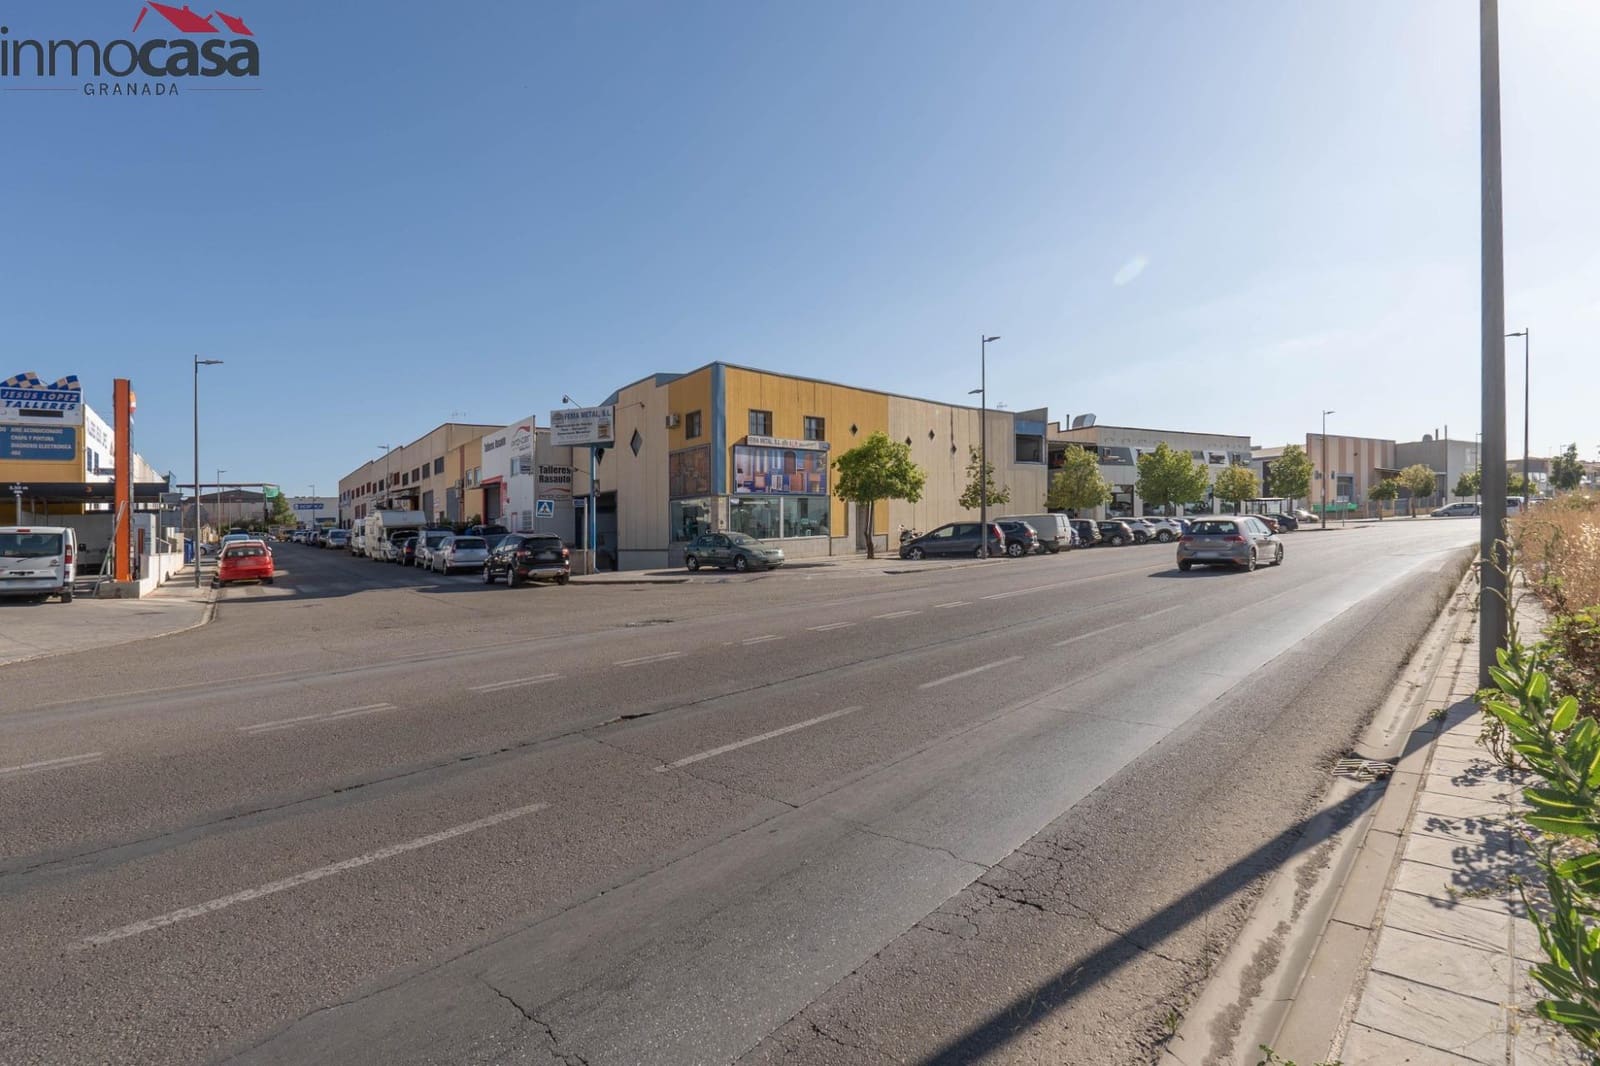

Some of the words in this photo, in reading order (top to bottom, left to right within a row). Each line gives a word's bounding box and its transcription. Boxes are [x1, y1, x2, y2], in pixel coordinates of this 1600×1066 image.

[3, 391, 39, 400] JESUS
[42, 393, 79, 402] LOPEZ
[6, 400, 77, 410] TALLERES
[538, 465, 571, 475] Talleres
[538, 475, 571, 484] Rasauto
